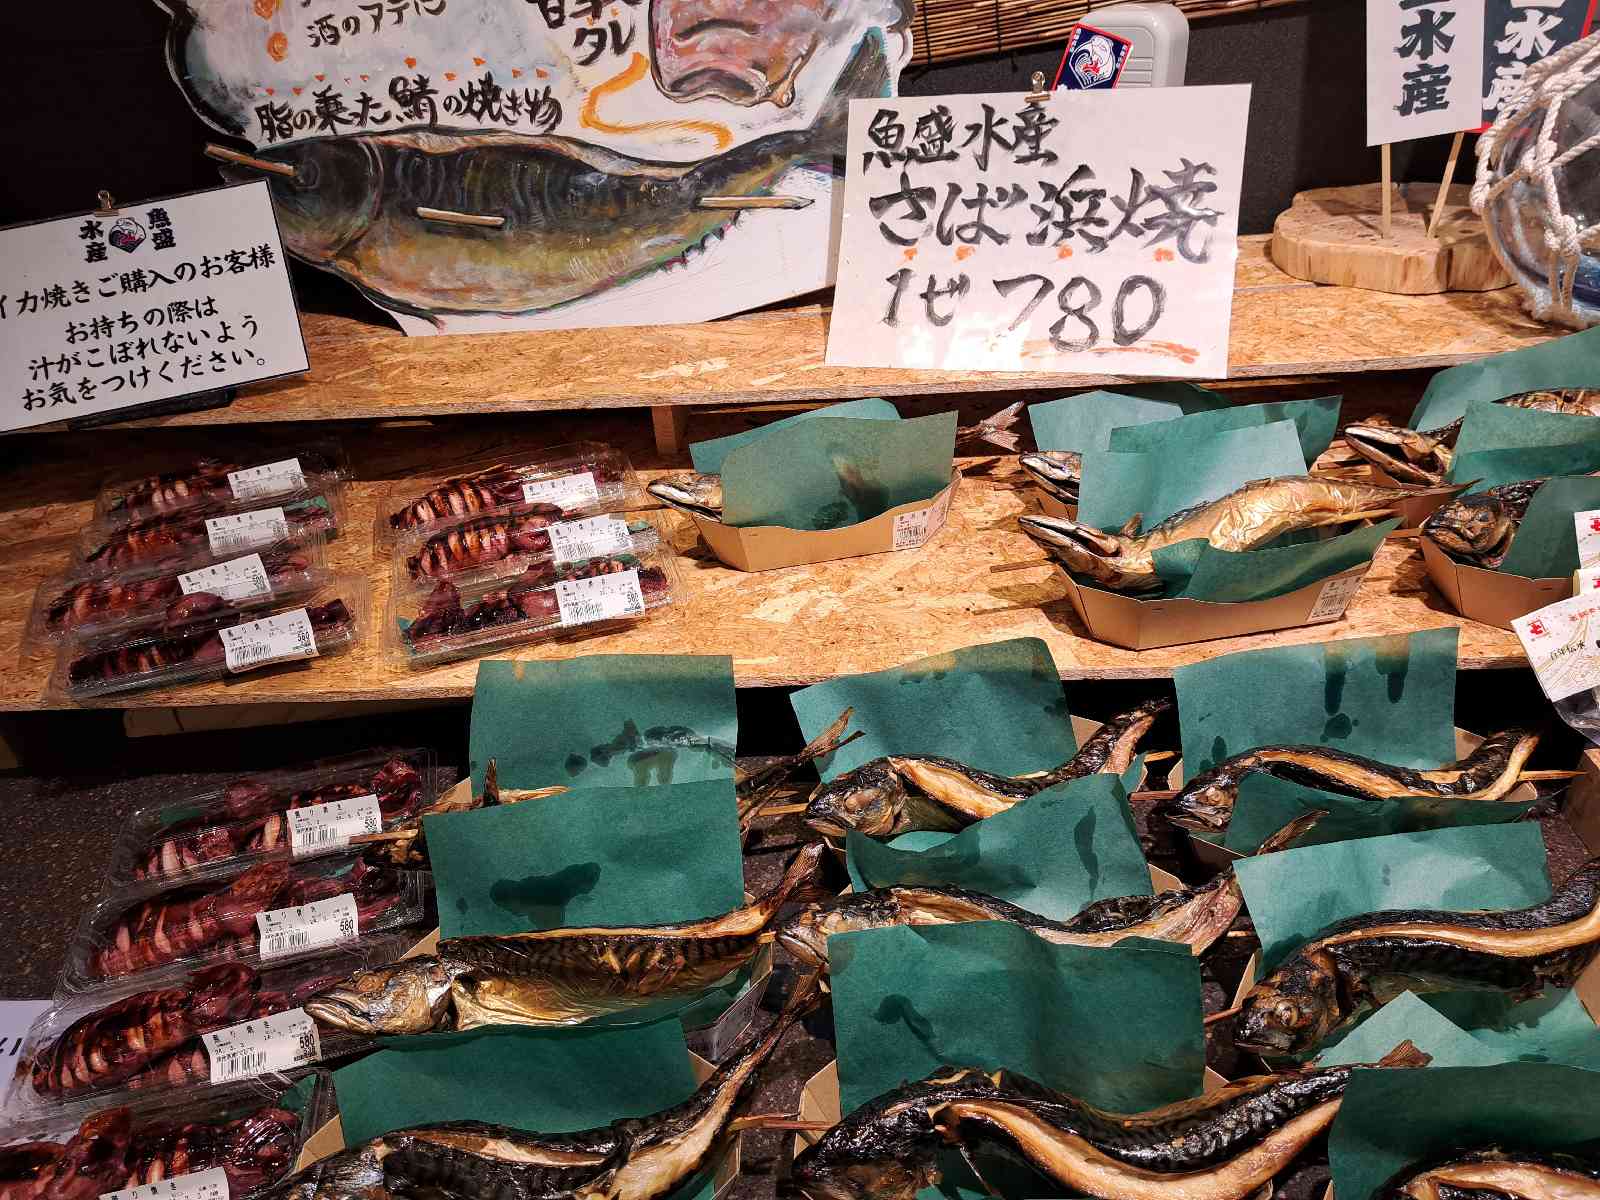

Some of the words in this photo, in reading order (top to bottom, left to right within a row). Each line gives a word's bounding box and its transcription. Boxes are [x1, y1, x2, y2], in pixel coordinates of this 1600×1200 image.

[573, 20, 636, 66] タレ
[1393, 0, 1457, 117] 水産
[862, 103, 1061, 174] 魚盛水産
[868, 158, 1225, 264] さば浜焼
[65, 296, 219, 345] お持ちの際は
[992, 274, 1167, 353] 780
[22, 349, 265, 411] お気をつけください。
[28, 315, 259, 381] 汁がこぼれないよう
[299, 1032, 315, 1049] 580
